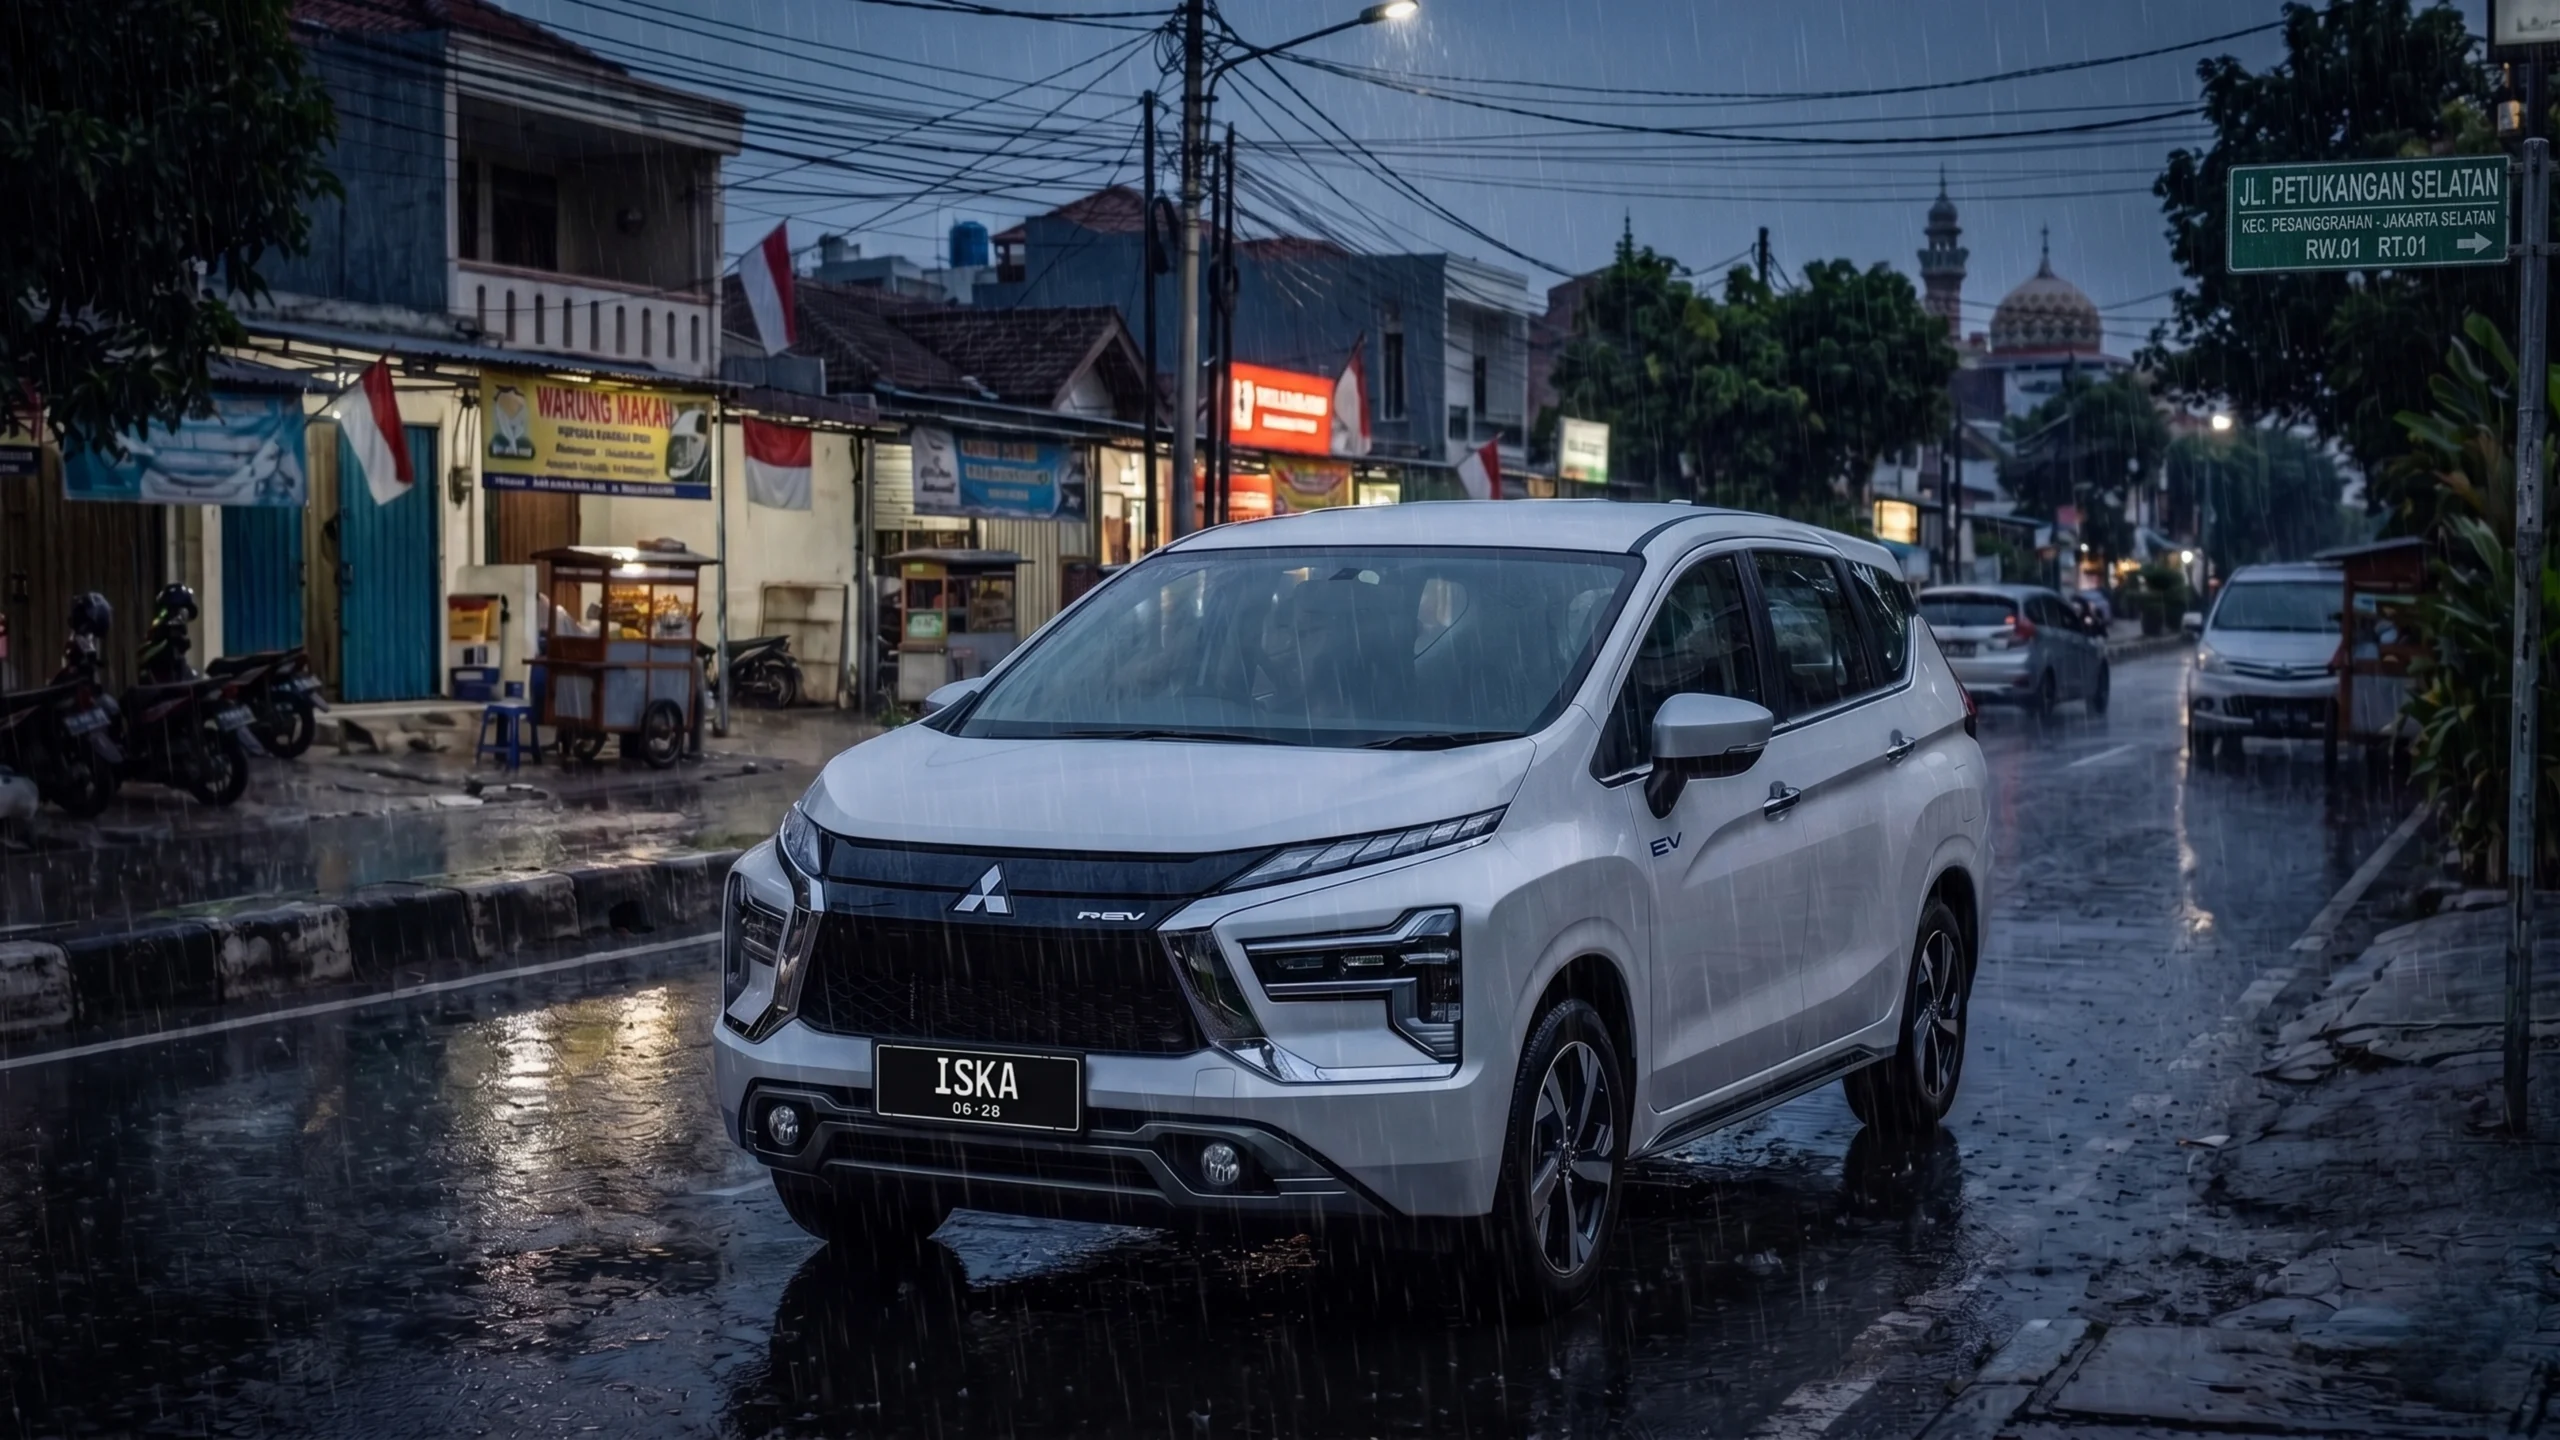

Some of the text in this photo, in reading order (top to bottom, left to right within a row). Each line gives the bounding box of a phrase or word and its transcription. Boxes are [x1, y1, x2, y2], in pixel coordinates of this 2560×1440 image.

[2239, 167, 2499, 207] JL. PETUKANGAN SELATAN
[2242, 217, 2269, 233] KEC.
[2272, 214, 2373, 232] PESANGGRAHAN
[2383, 211, 2438, 229] JAKARTA
[2441, 209, 2496, 227] SELATAN
[2306, 235, 2426, 260] RW.01 RT.01
[536, 385, 612, 424] WARUNG
[1650, 831, 1682, 858] EV
[935, 1057, 1018, 1100] ISKA
